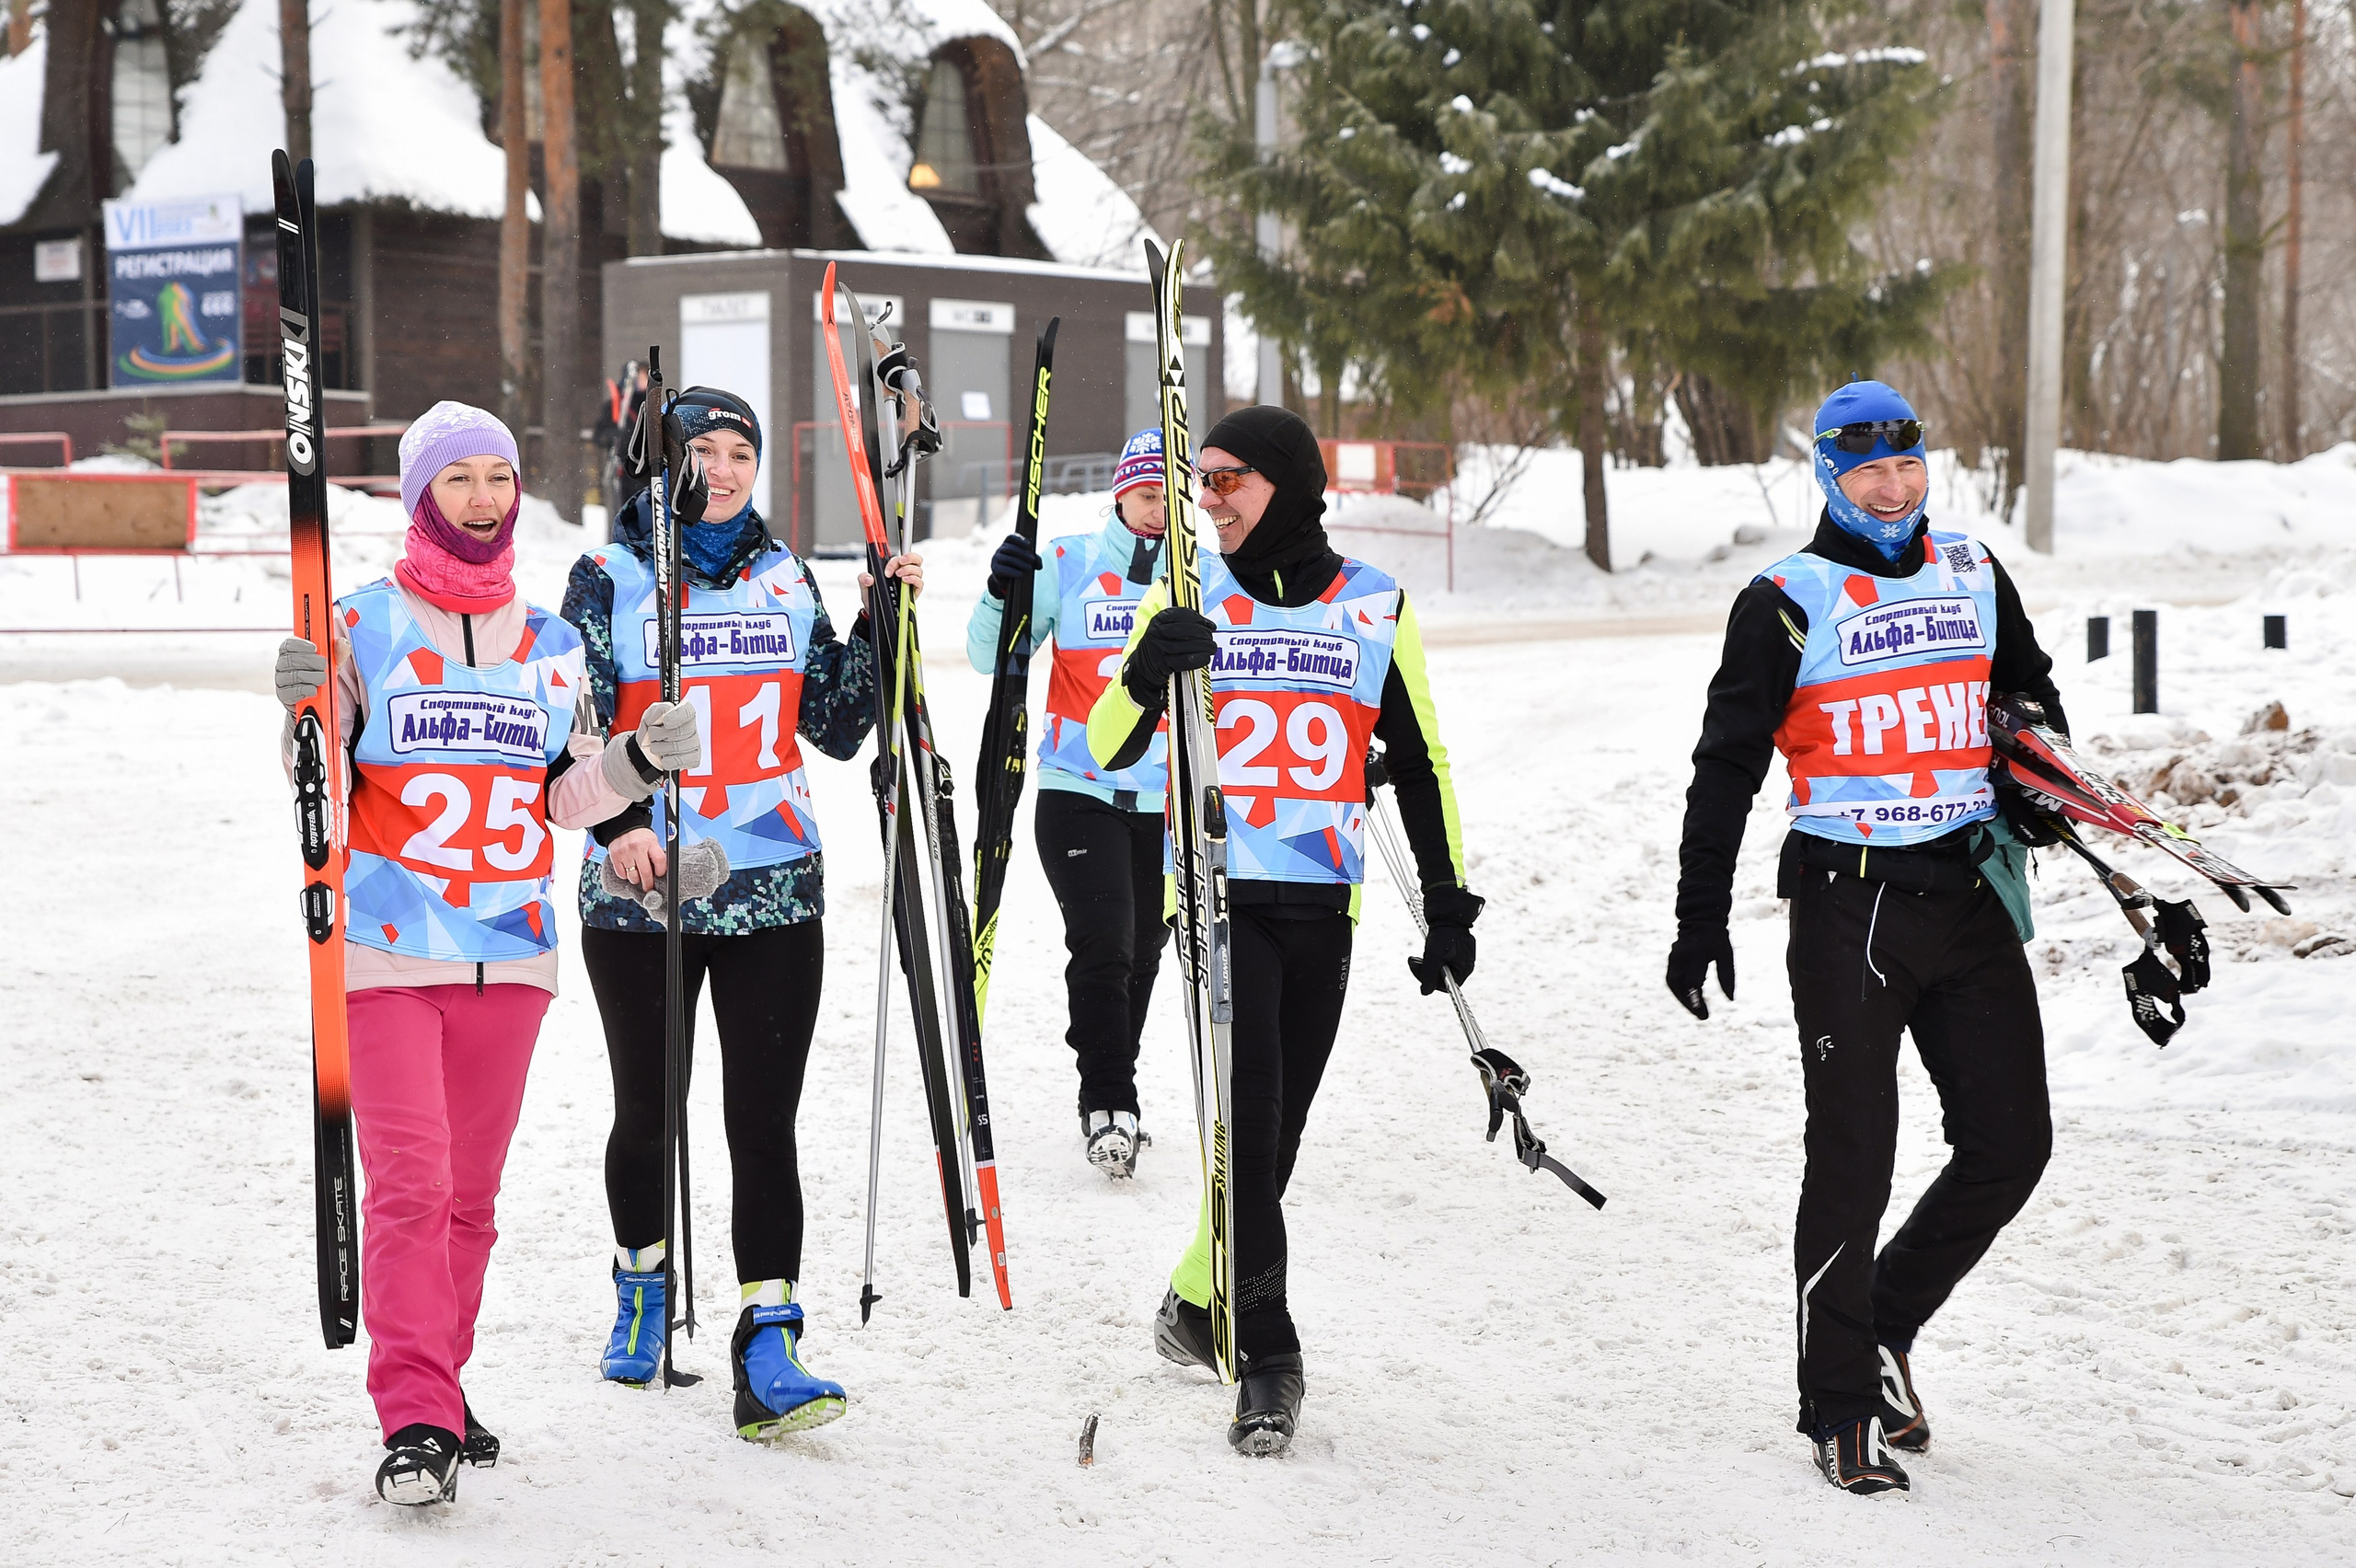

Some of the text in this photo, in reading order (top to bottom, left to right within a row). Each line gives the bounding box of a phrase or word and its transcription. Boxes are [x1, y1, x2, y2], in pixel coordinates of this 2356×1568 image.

[115, 248, 235, 279] РЕГИСТРАЦИЯ
[708, 409, 742, 421] grom
[1026, 366, 1051, 519] FISCHER
[1171, 392, 1201, 615] FISCHER
[655, 502, 668, 595] NORDWAY
[745, 619, 771, 629] клуб
[1849, 615, 1979, 656] Альфа-Битца
[1865, 604, 1961, 626] Спортивный клуб
[1211, 647, 1353, 679] Альфа-Битца
[1230, 637, 1343, 651] Спортивный клуб
[420, 699, 505, 713] Спортивный
[1200, 666, 1215, 725] SKATIN
[401, 712, 543, 751] Альфа-Битц
[681, 681, 781, 777] 11
[1216, 698, 1348, 791] 29
[306, 809, 318, 847] ROTTEFELLA
[399, 772, 546, 871] 25
[1174, 846, 1194, 986] FISCHER
[1194, 849, 1208, 990] FISCHER
[1220, 944, 1230, 1001] SALOMON
[977, 1113, 988, 1125] S5
[1214, 1120, 1226, 1189] SKATING
[334, 1176, 346, 1242] SKATE
[339, 1248, 349, 1301] RACE
